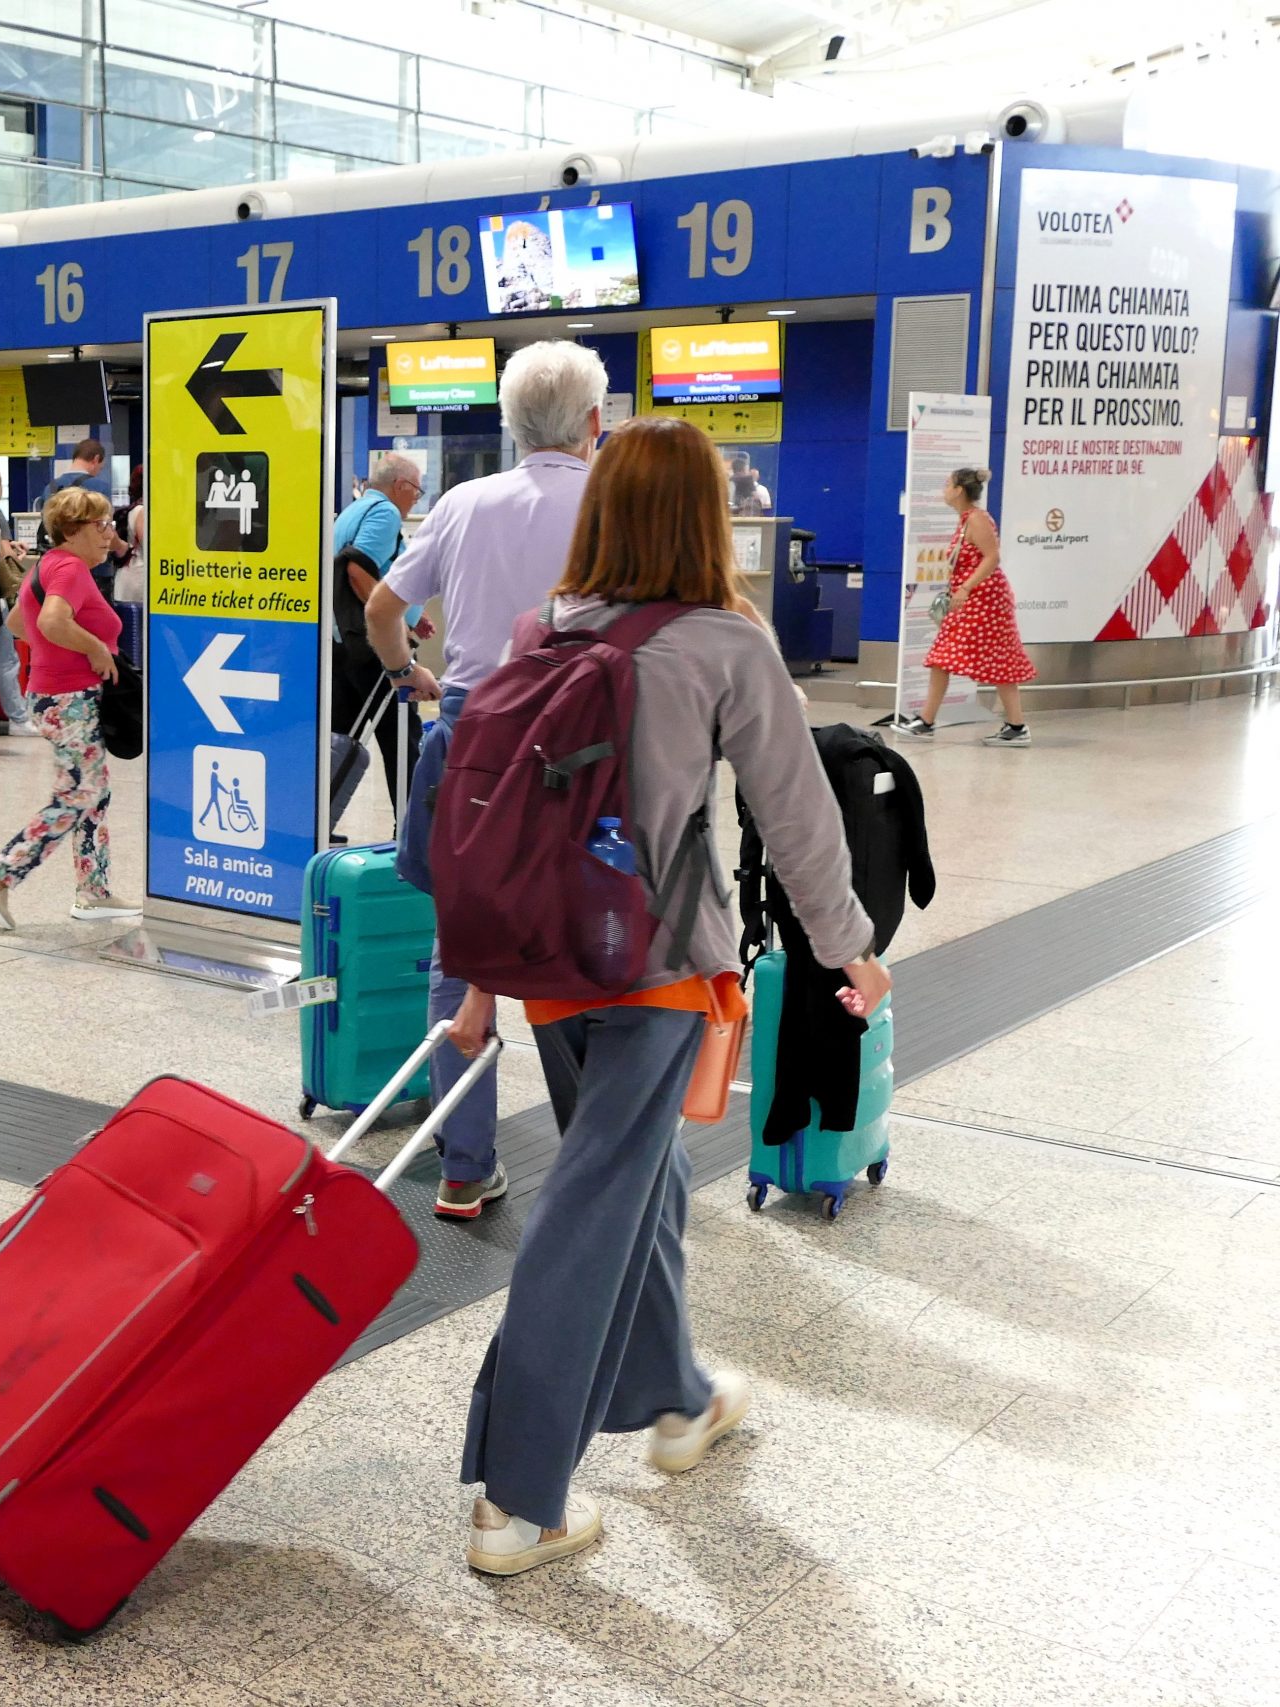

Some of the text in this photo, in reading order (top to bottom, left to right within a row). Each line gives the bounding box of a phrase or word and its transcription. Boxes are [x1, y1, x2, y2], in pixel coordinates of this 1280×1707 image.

[909, 186, 952, 254] B
[1038, 211, 1112, 234] VOLOTEA
[677, 199, 753, 279] 19
[236, 241, 294, 304] 17
[407, 224, 471, 298] 18
[35, 262, 85, 325] 16
[1032, 284, 1189, 317] ULTIMA CHIAMATA
[690, 340, 768, 357] Lufthansa
[1029, 322, 1199, 354] PER QUESTO VOLO?
[419, 355, 486, 370] Lufthansa
[1026, 360, 1179, 390] PRIMA CHIAMATA
[692, 395, 727, 403] ALLIANCE
[738, 393, 759, 401] GOLD
[1024, 398, 1183, 427] PER IL PROSSIMO.
[1023, 440, 1182, 456] SCOPRI LE NOSTRE DESTINAZIONI
[1021, 460, 1029, 475] E
[1032, 460, 1059, 475] VOLA
[1061, 460, 1070, 475] A
[1072, 460, 1113, 475] PARTIRE
[1116, 460, 1129, 475] DA
[1017, 534, 1089, 545] Cagliari Airport
[159, 559, 308, 581] Biglietterie aeree
[157, 587, 311, 613] Airline ticket offices
[184, 846, 273, 878] Sala amica
[185, 875, 273, 907] PRM room
